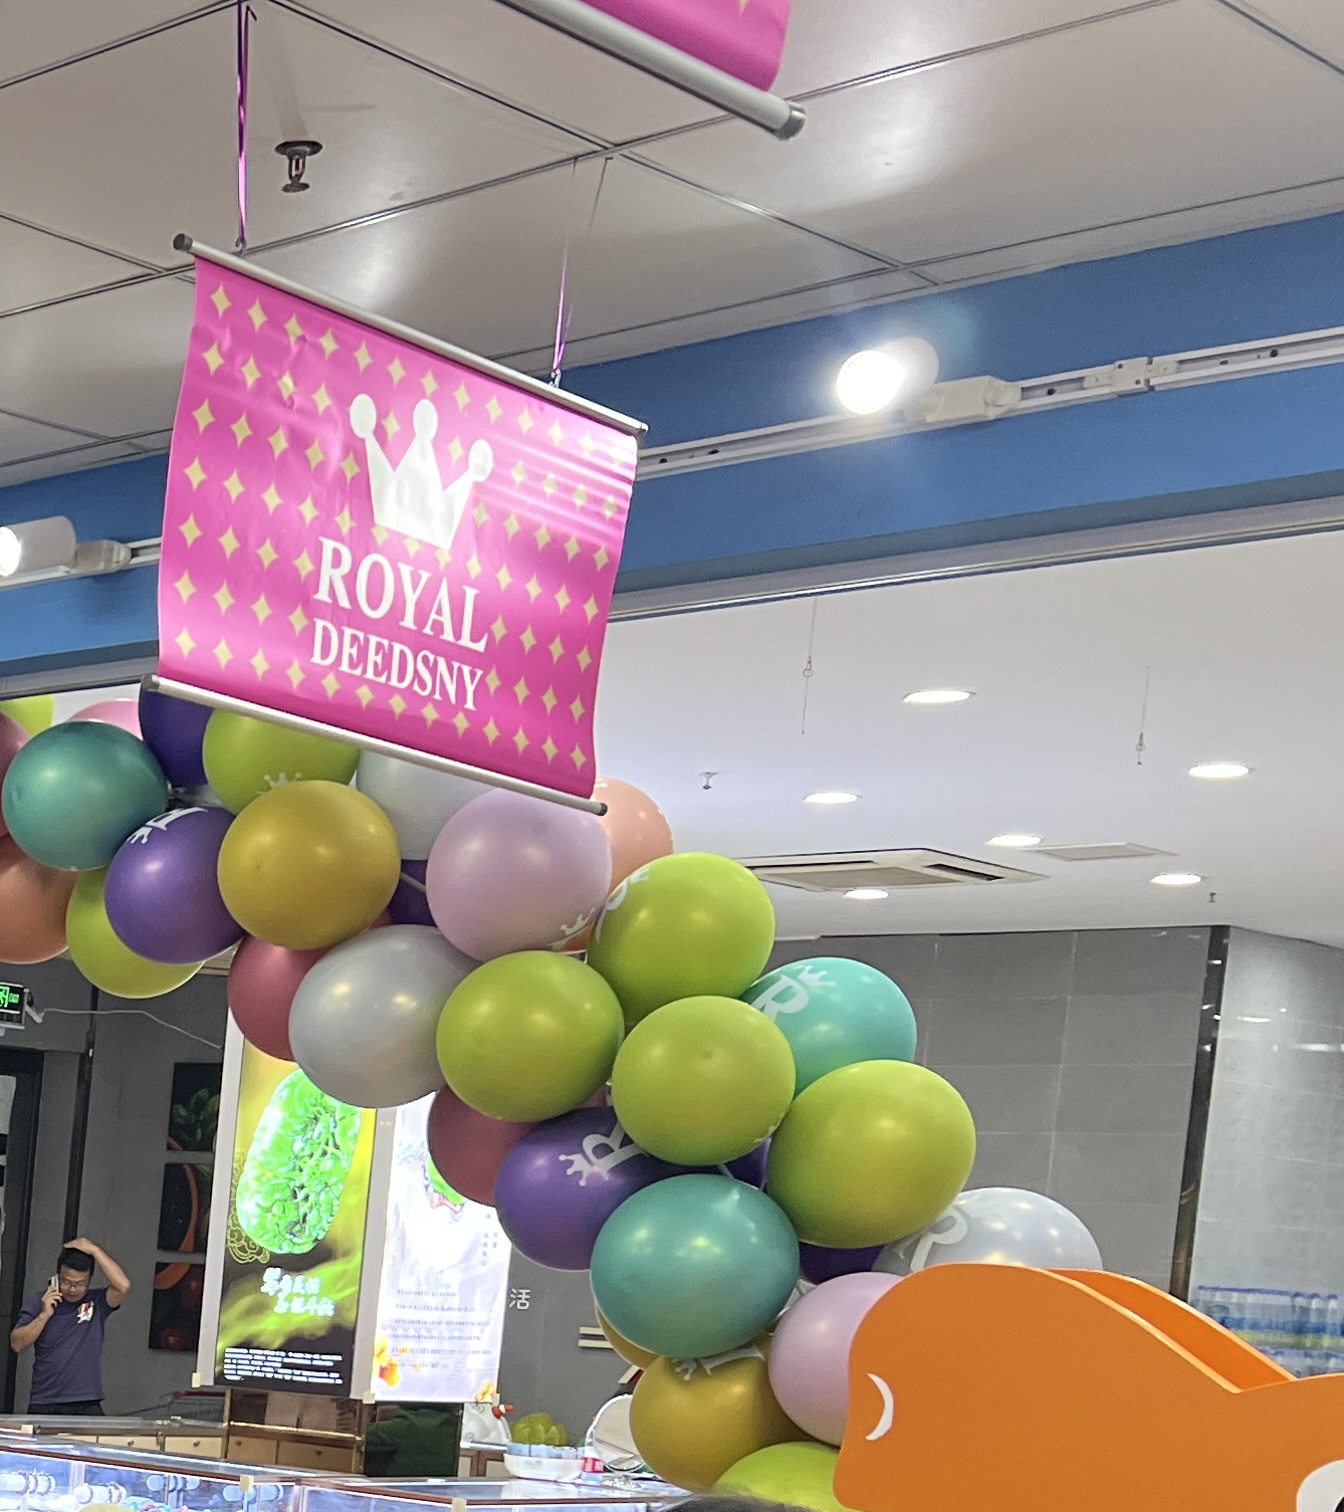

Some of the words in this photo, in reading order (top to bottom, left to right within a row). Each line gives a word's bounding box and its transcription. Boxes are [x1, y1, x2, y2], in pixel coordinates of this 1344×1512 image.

[313, 536, 489, 653] ROYAL
[310, 617, 484, 711] DEEDSNY
[508, 1288, 531, 1310] 活
